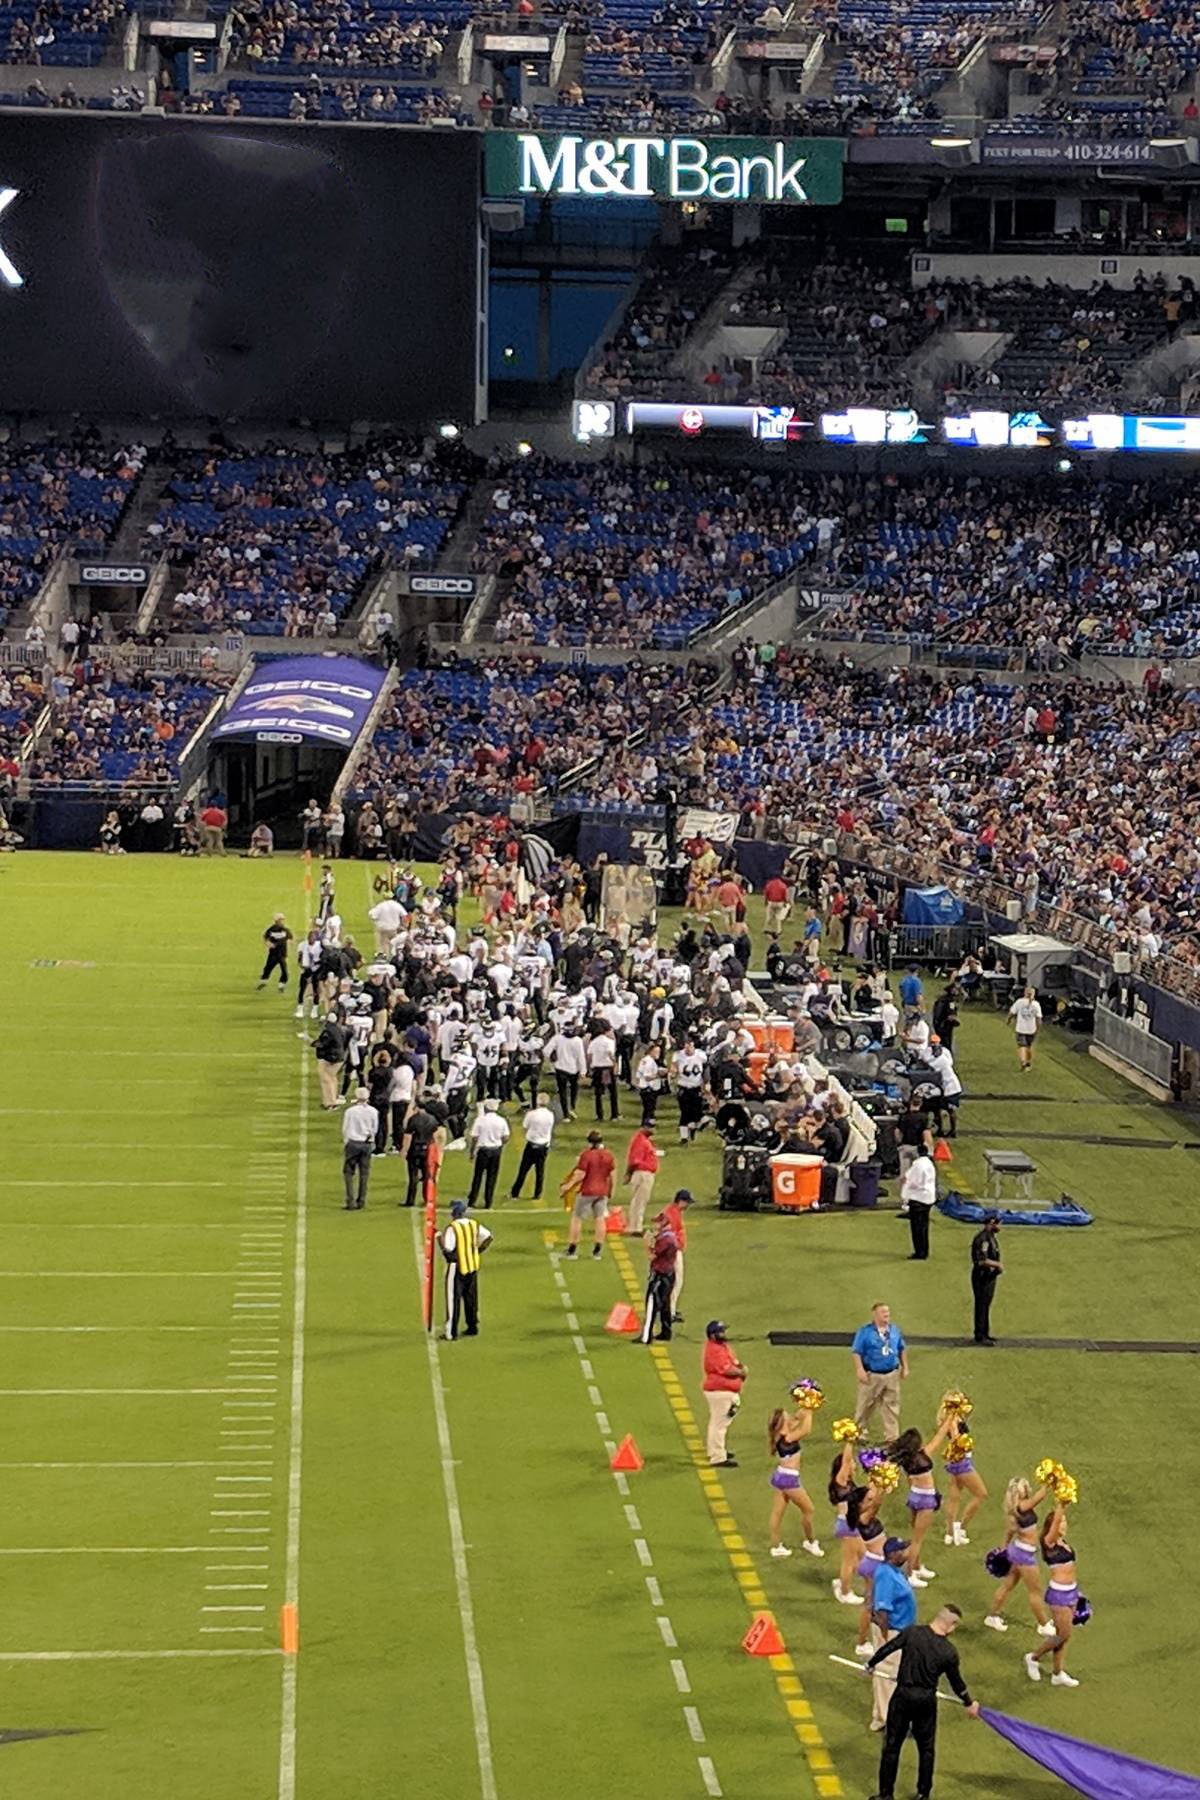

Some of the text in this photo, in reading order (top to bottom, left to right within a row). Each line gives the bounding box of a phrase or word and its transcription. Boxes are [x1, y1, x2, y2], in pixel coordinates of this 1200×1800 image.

[517, 135, 808, 200] M&T Bank
[82, 567, 146, 582] GEICO
[411, 577, 473, 592] GEICO
[244, 680, 373, 700] GEICO
[219, 718, 351, 739] GEICO
[256, 732, 303, 743] GEICO
[483, 1045, 498, 1059] 45
[777, 1170, 796, 1195] G
